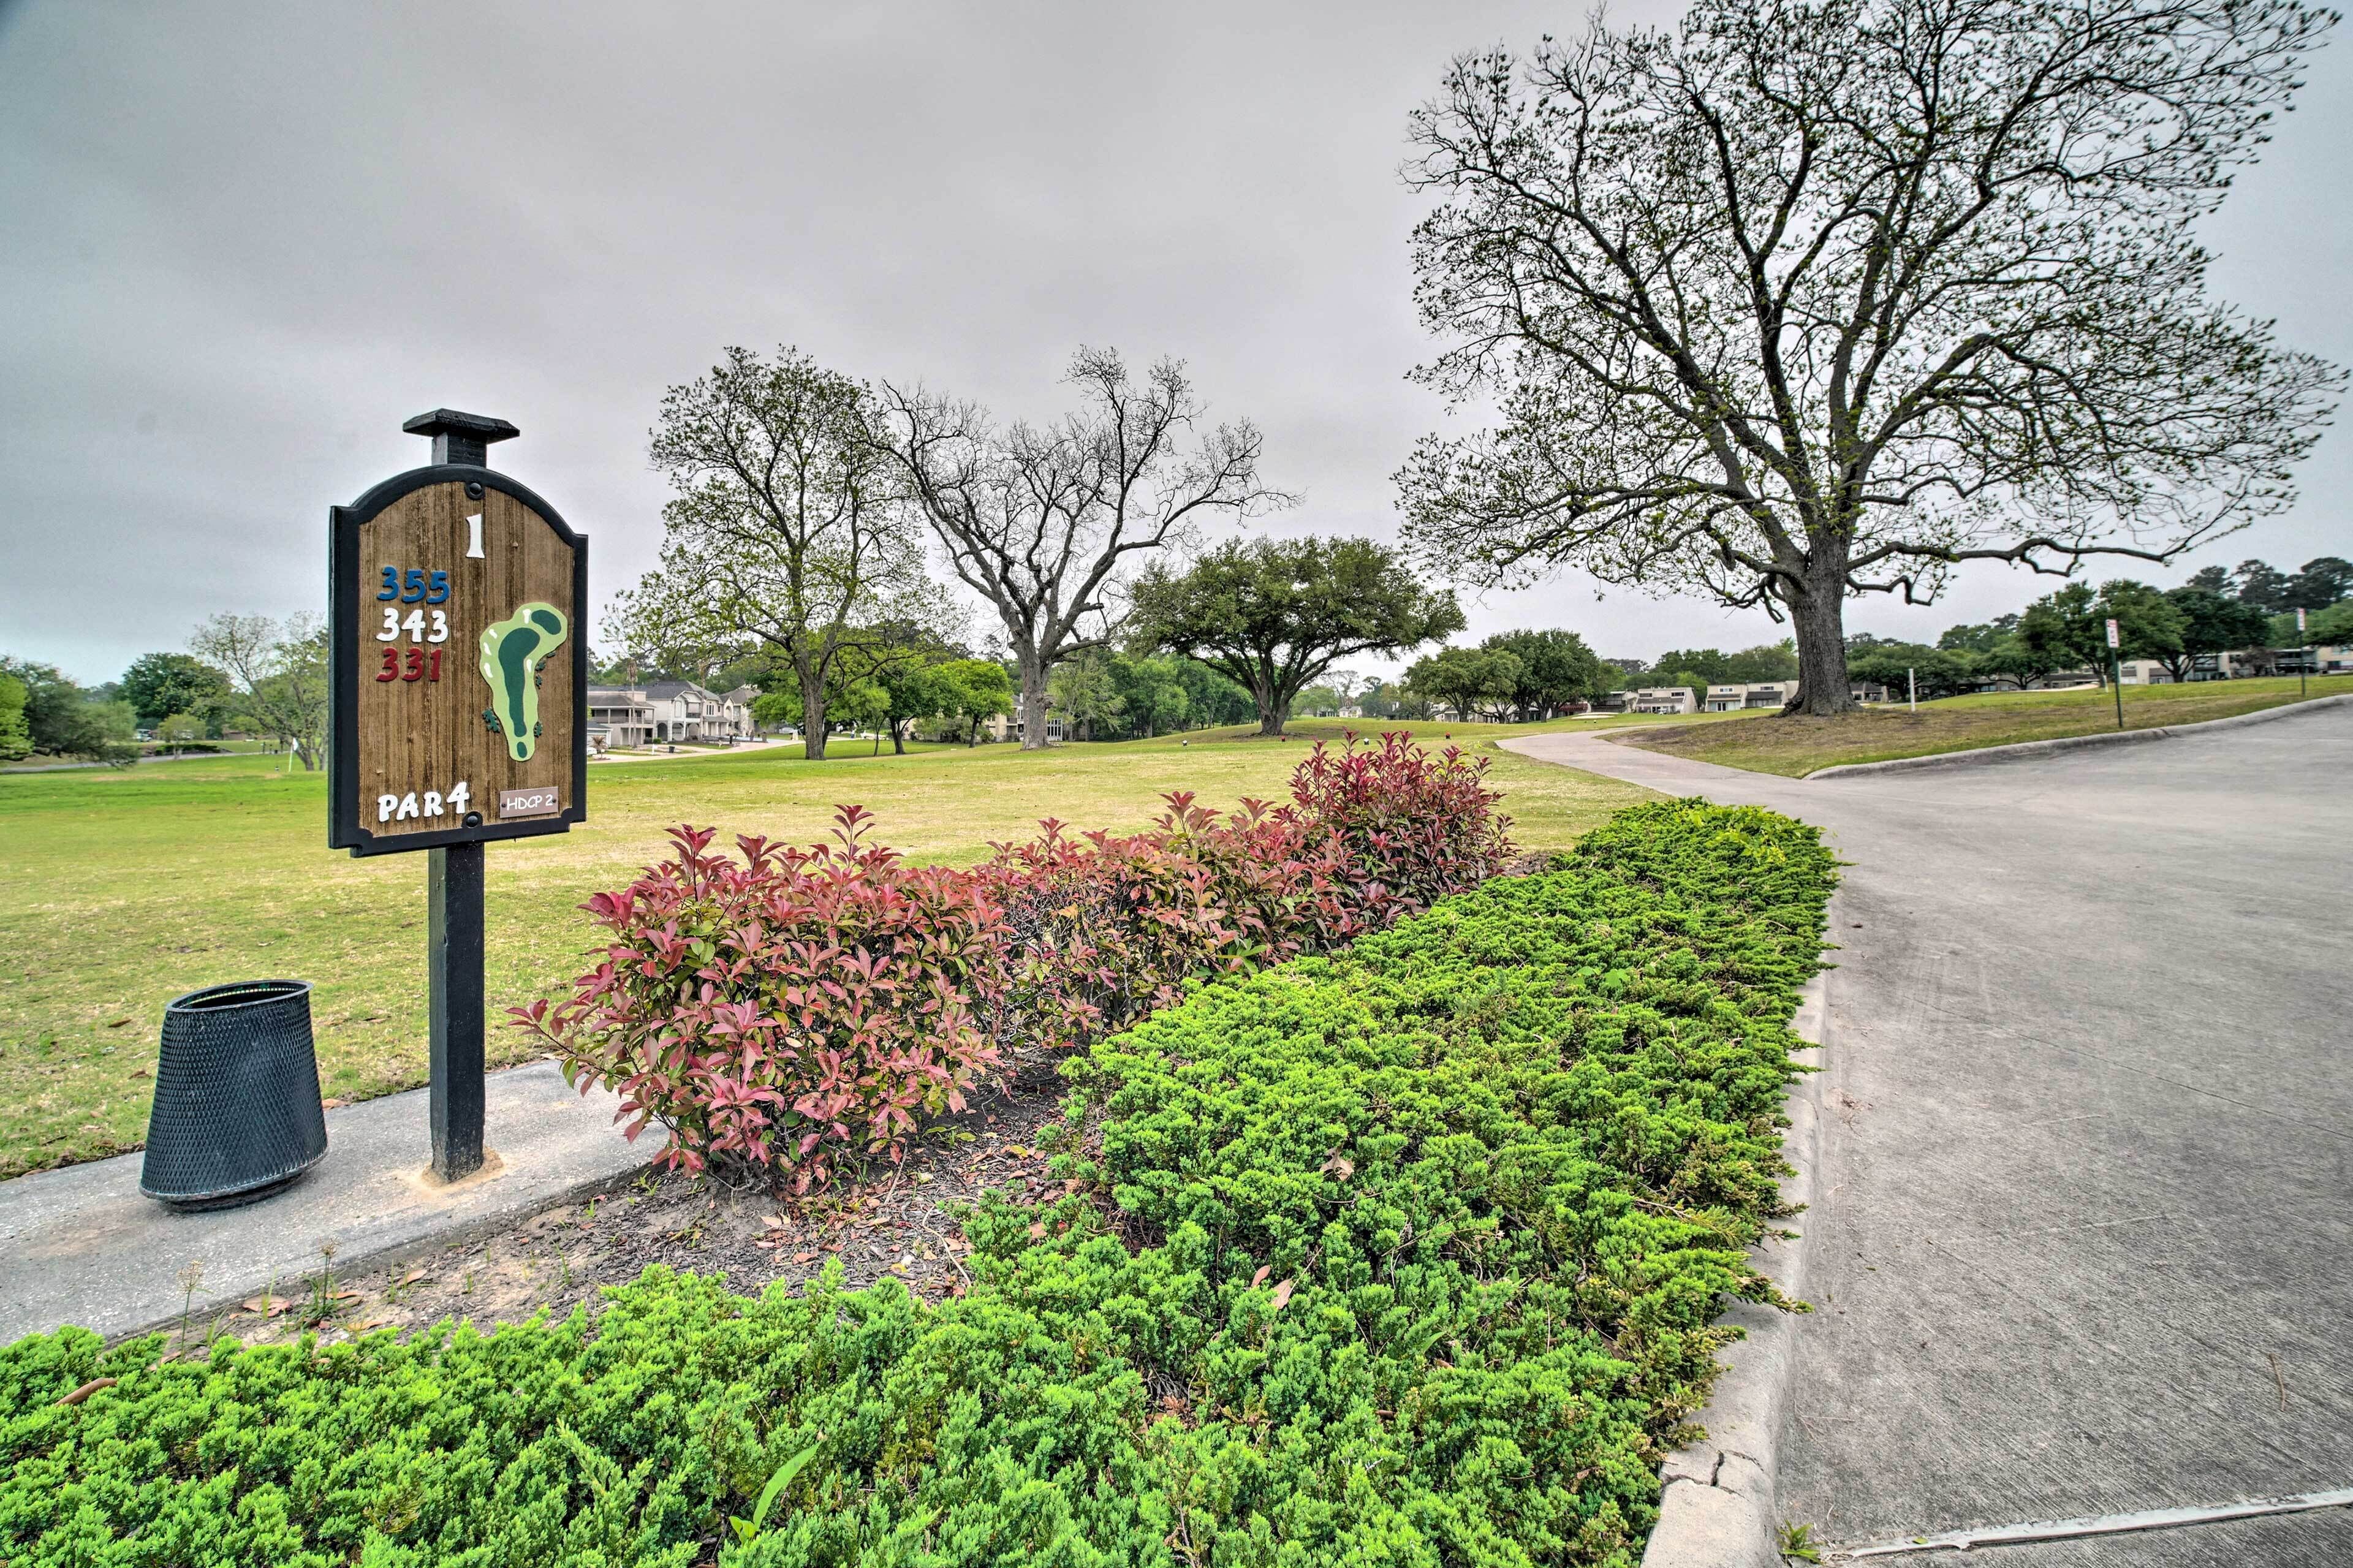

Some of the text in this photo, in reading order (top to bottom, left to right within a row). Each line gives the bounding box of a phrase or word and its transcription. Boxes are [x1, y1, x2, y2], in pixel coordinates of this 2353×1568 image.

[466, 513, 485, 558] 1
[377, 566, 450, 603] 355
[376, 608, 449, 643] 343
[376, 647, 442, 682] 331
[377, 782, 469, 822] PAR 4
[506, 794, 553, 811] HDCP 2
